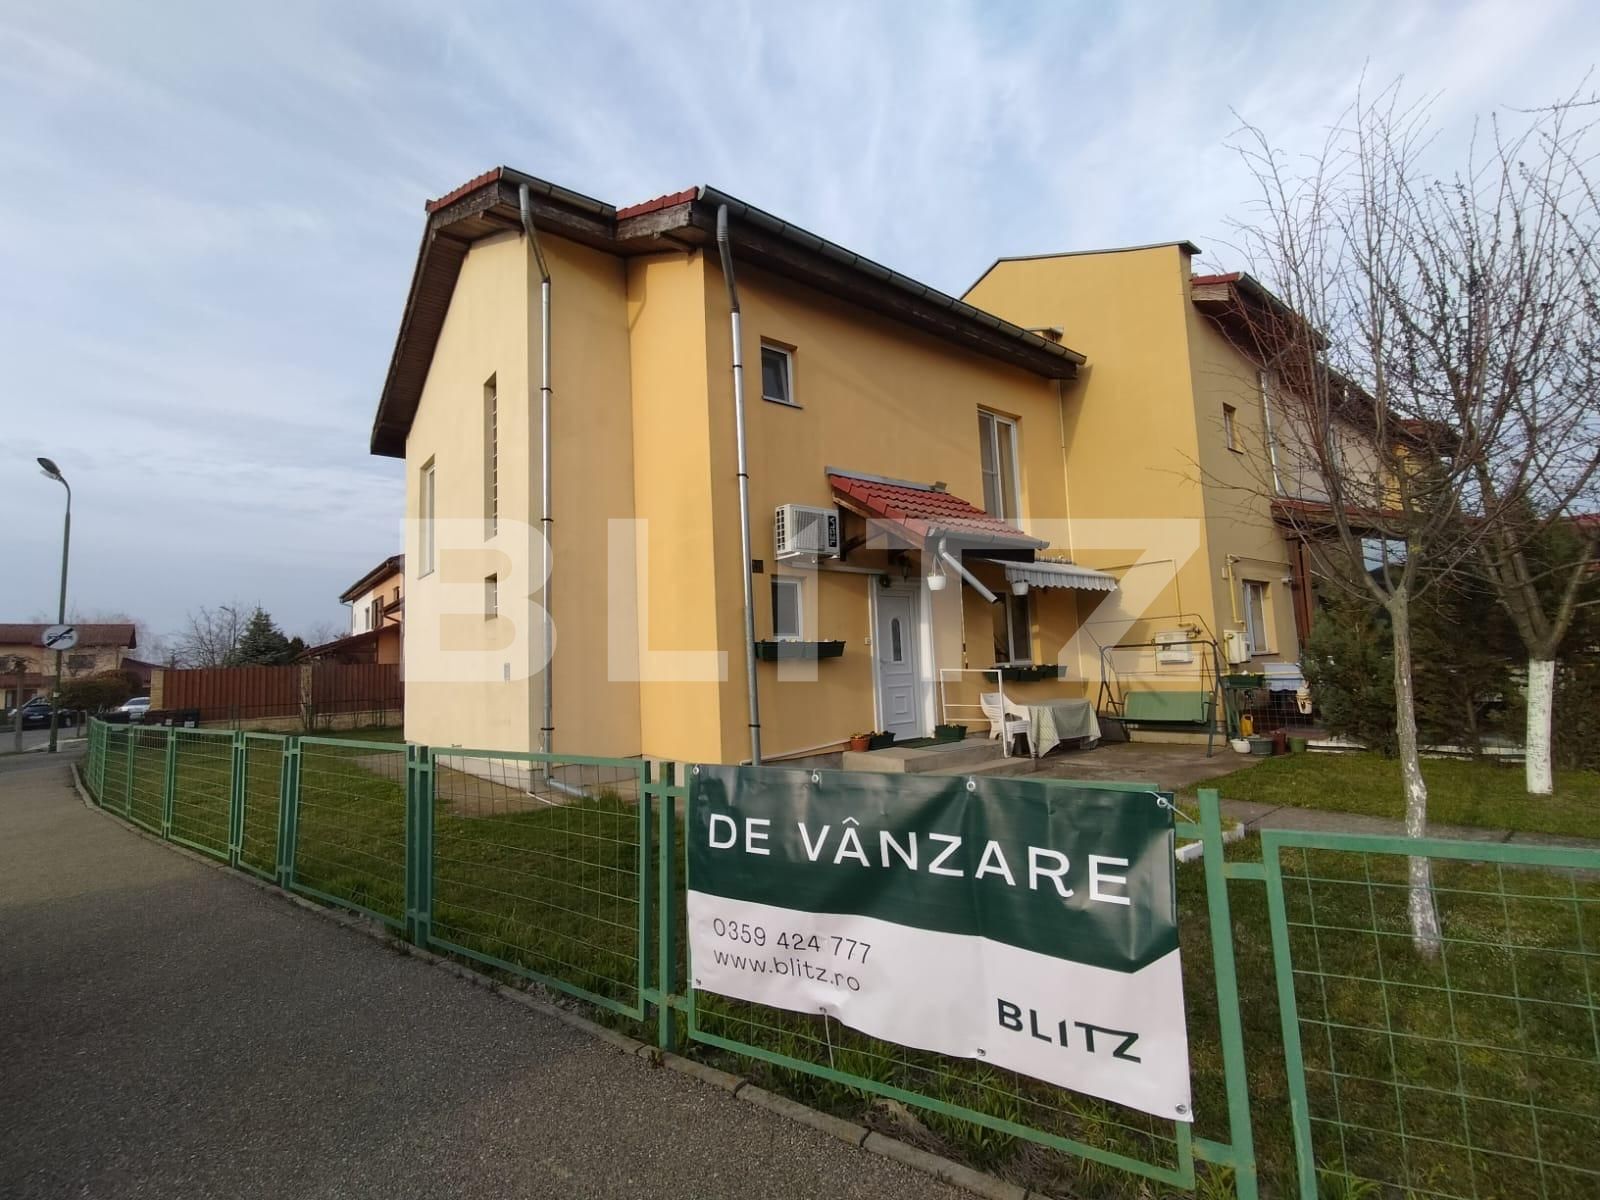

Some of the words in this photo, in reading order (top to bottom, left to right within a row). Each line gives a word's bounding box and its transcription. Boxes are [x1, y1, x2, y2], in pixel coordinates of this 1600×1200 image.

[708, 813, 771, 856] DE
[798, 817, 1132, 906] VÂNZARE
[713, 918, 766, 947] 0359
[777, 932, 821, 953] 424
[831, 936, 871, 964] 777
[713, 949, 861, 992] www.blitz.ro
[997, 998, 1142, 1064] BLITZ
